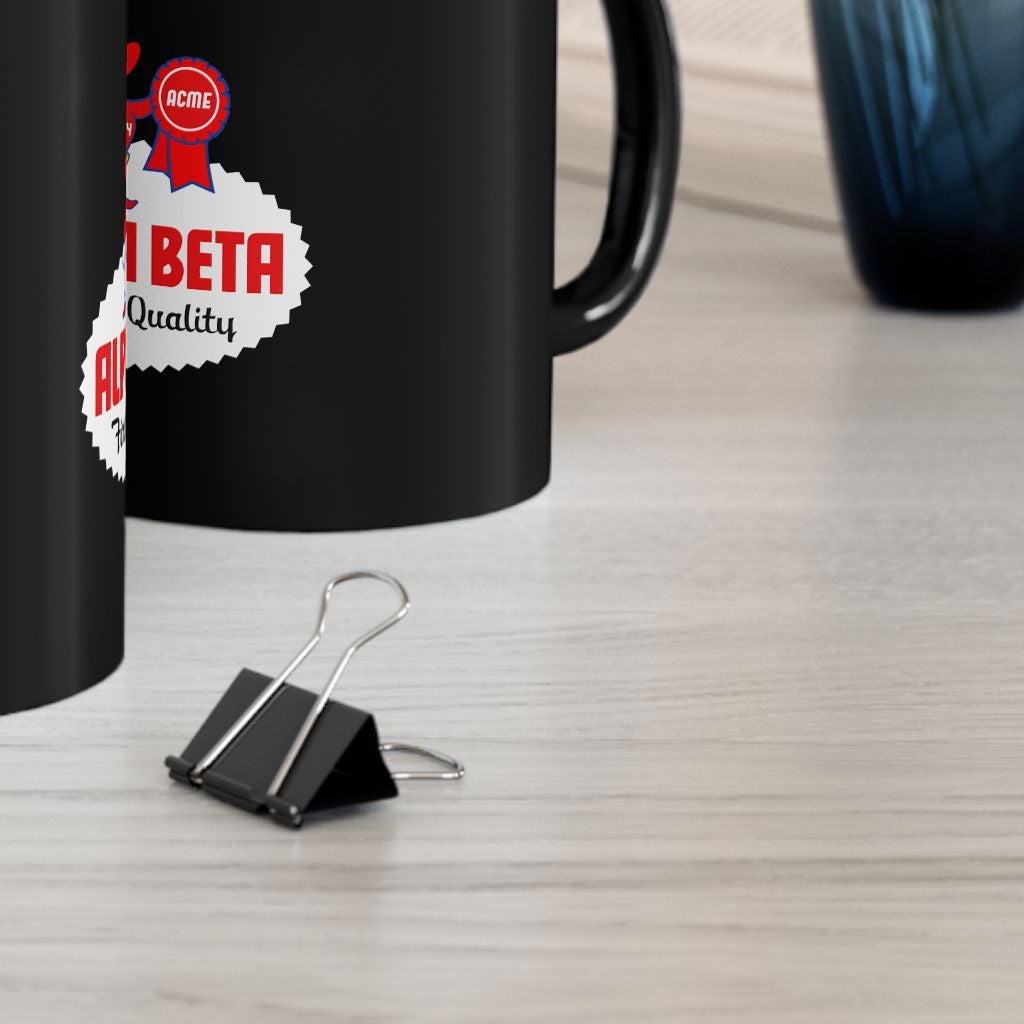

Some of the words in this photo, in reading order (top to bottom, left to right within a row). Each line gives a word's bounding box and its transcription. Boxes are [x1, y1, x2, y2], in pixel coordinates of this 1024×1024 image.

[166, 89, 212, 110] ACME
[151, 224, 284, 295] BETA
[127, 295, 236, 343] Quality
